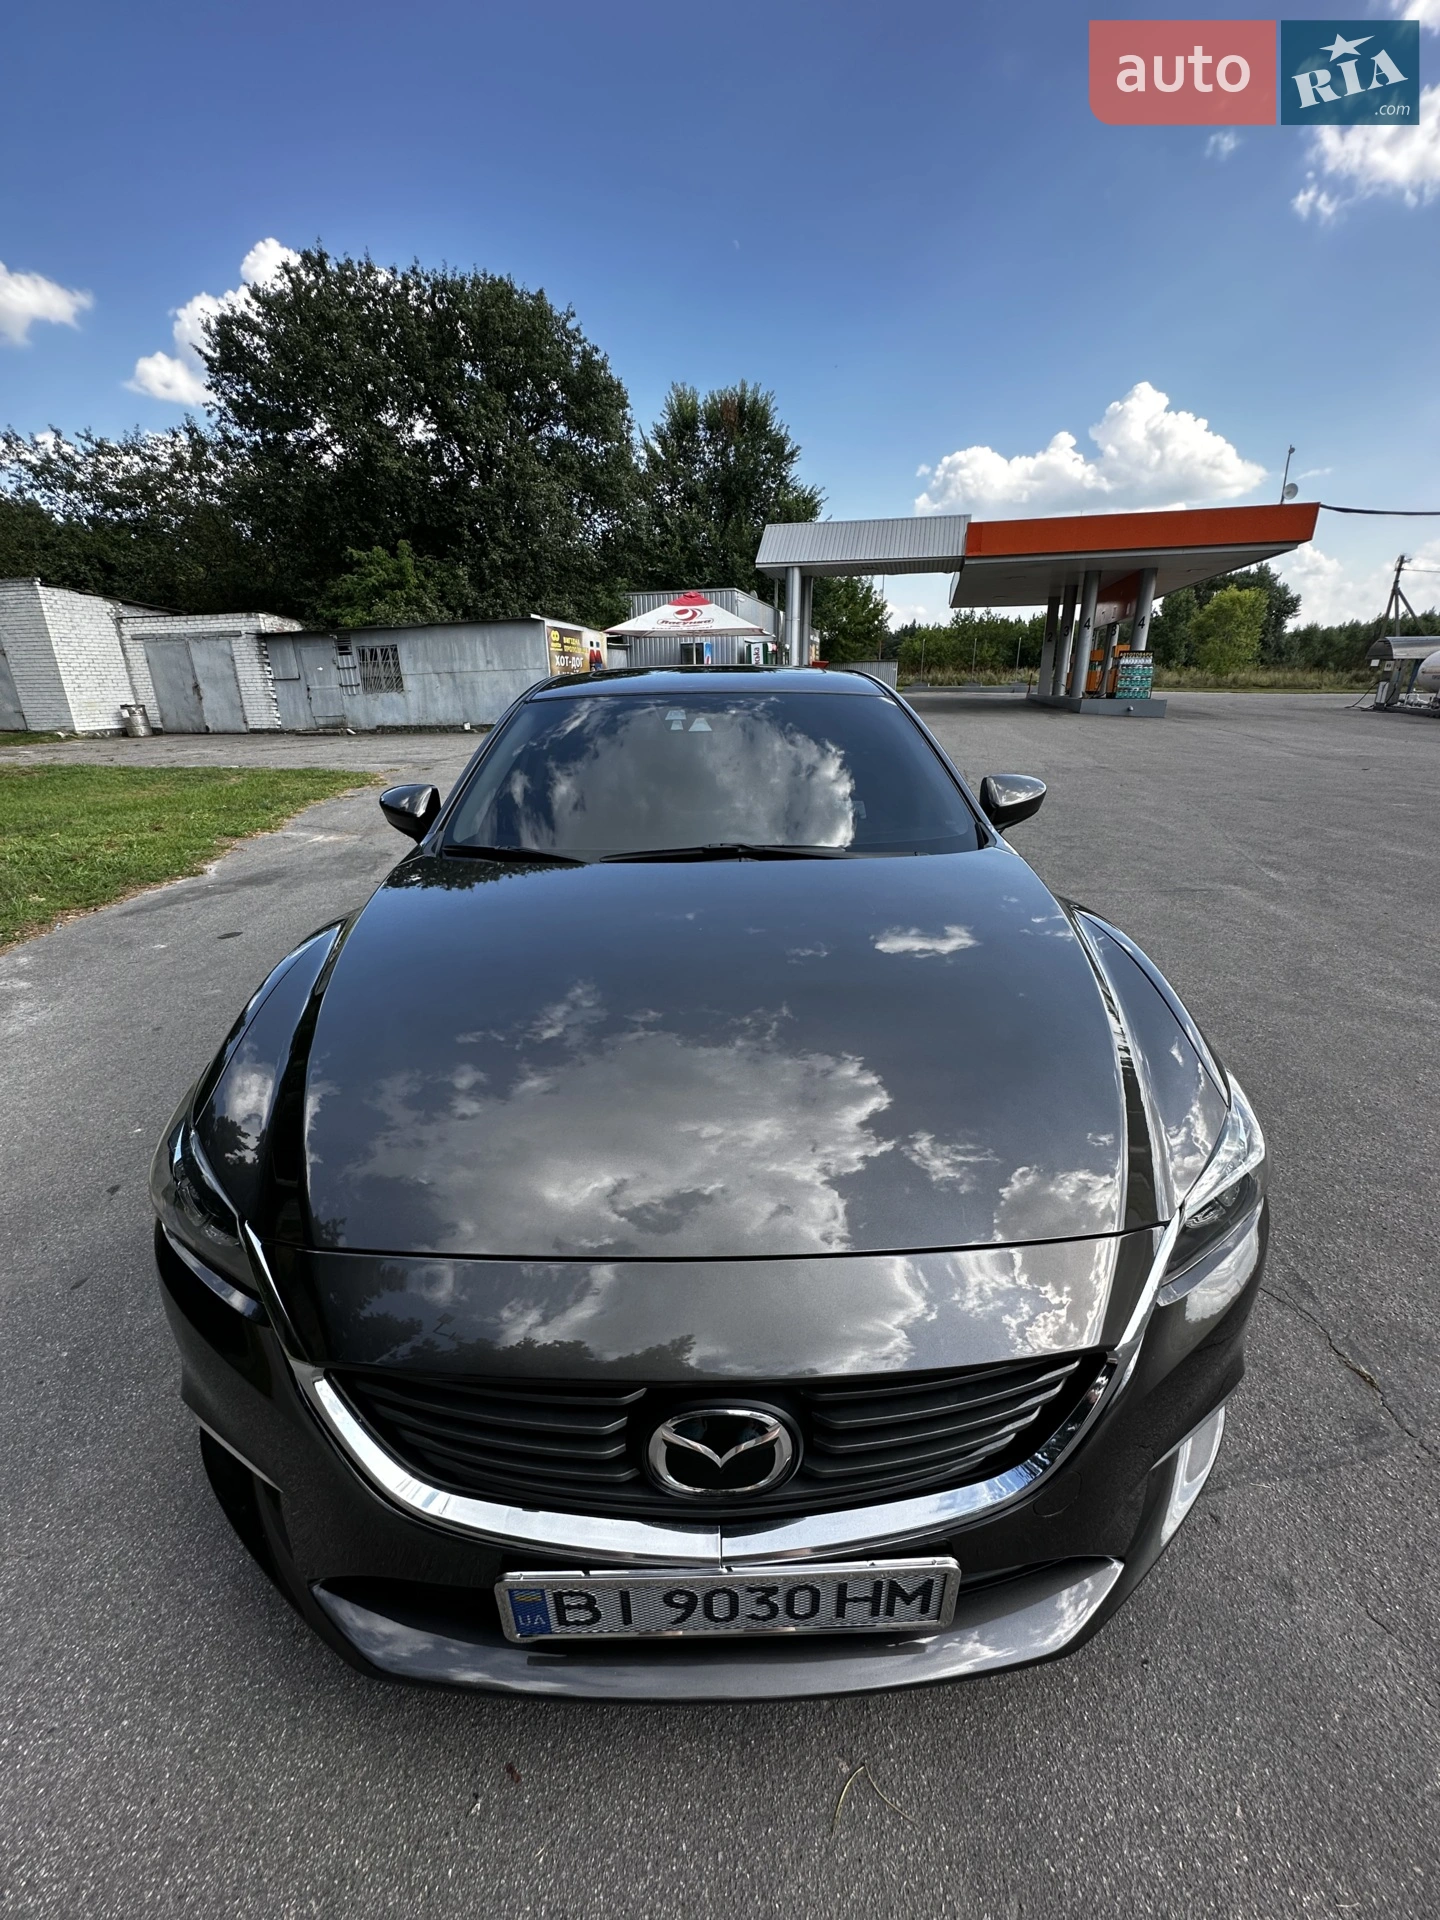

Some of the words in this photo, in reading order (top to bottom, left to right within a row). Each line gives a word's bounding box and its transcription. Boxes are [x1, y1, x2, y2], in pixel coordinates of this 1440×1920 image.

[1084, 617, 1091, 630] 4
[1138, 616, 1146, 629] 4
[1047, 632, 1053, 642] 2
[1063, 626, 1070, 637] 3
[555, 655, 584, 669] ХОТ-ДОГ
[663, 1583, 821, 1625] 9030
[835, 1578, 935, 1619] HM
[518, 1614, 546, 1626] UA
